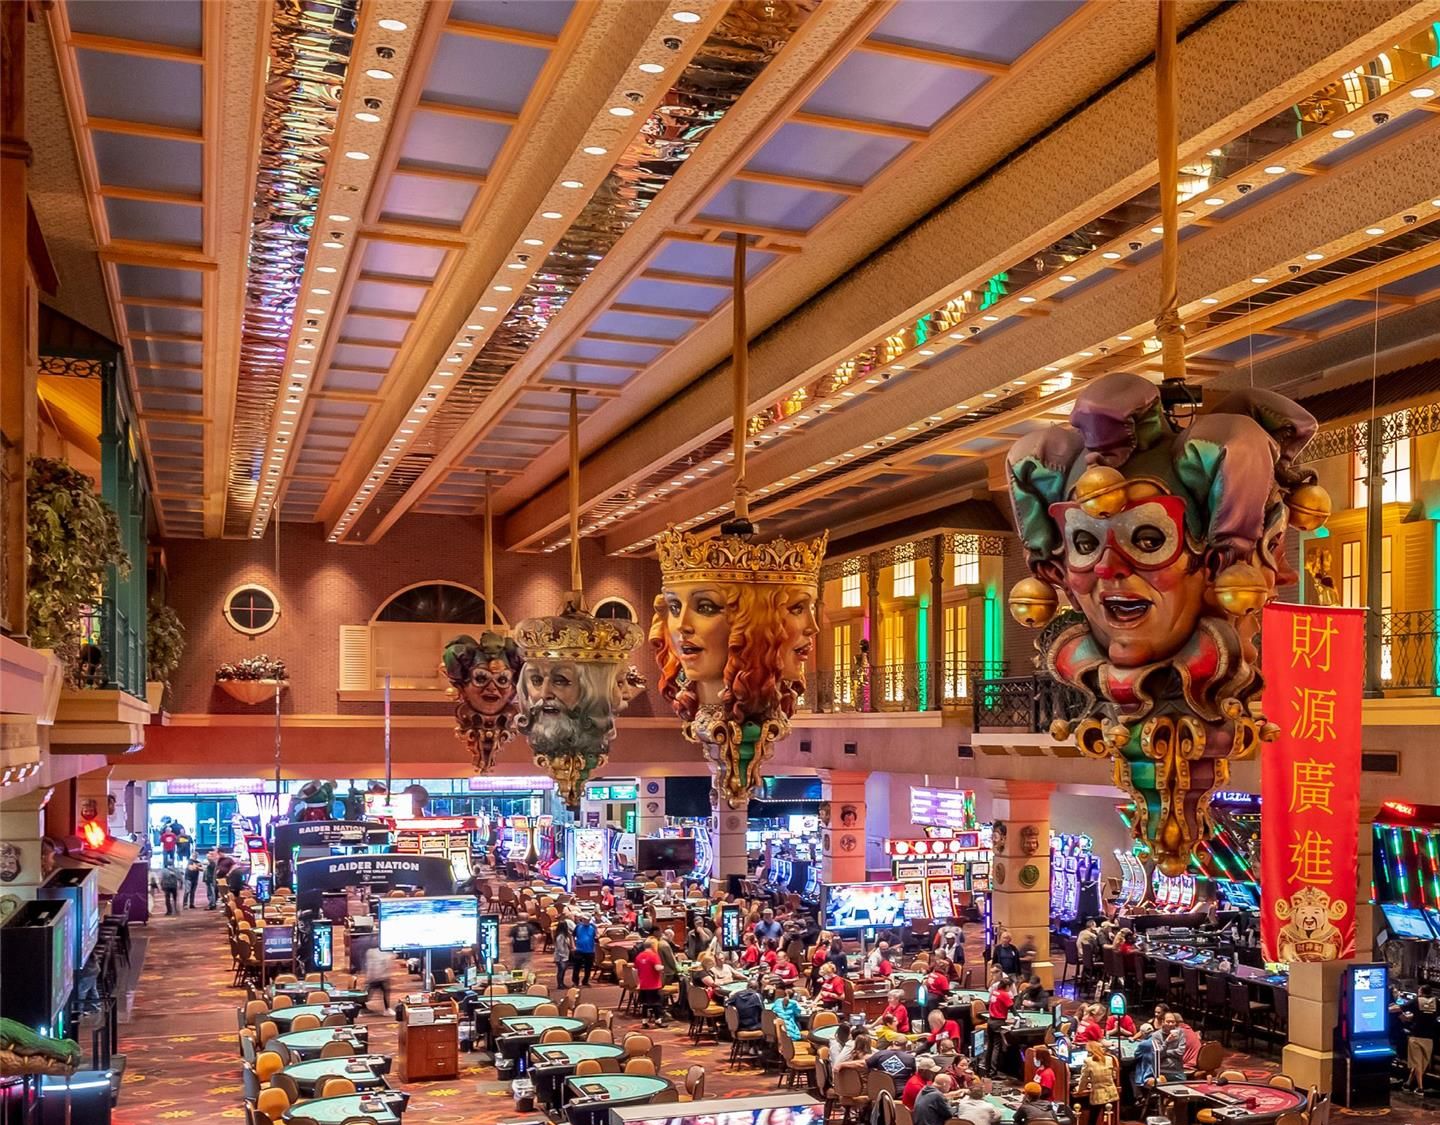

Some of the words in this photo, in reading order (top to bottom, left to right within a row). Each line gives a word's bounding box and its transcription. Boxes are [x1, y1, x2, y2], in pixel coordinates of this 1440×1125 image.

[1288, 614, 1340, 887] 財源廣進
[298, 825, 330, 835] RAIDER
[333, 824, 366, 834] NATION
[329, 861, 372, 874] RAIDER
[375, 861, 420, 872] NATION
